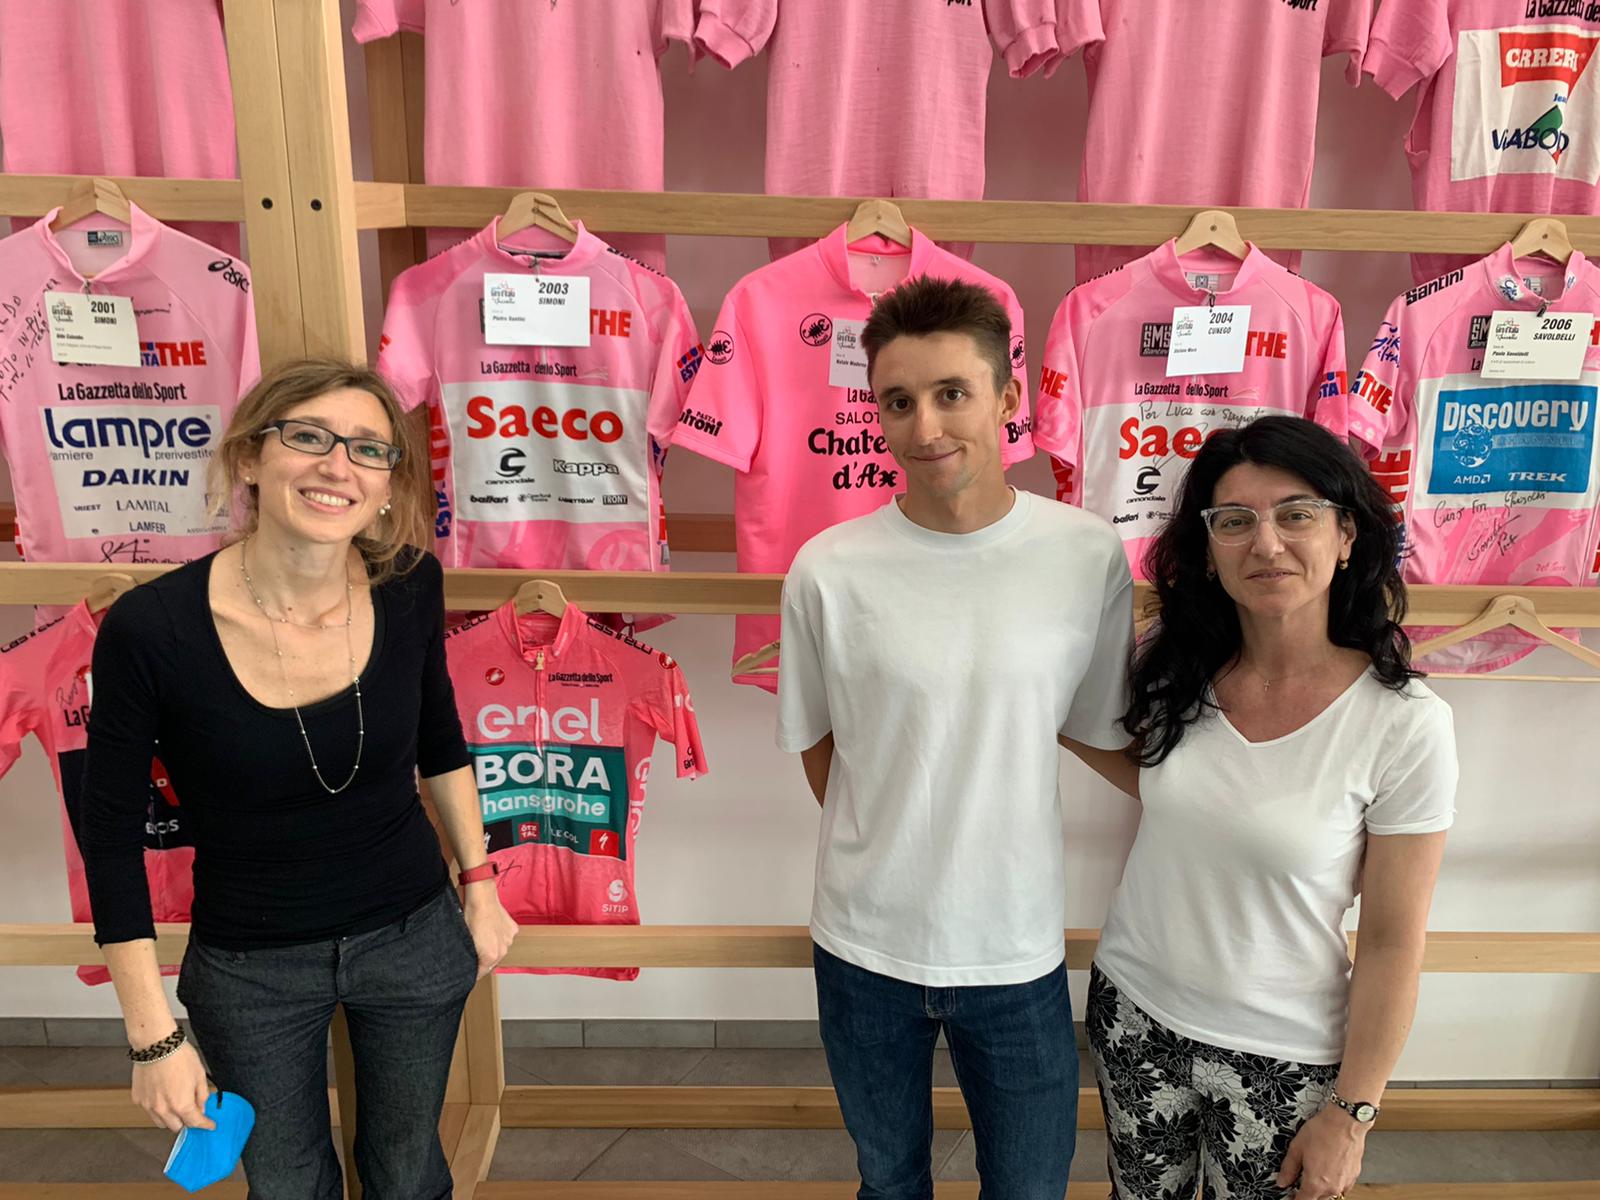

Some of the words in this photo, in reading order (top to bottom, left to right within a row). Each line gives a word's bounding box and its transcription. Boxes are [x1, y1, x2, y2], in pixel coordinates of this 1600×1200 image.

[538, 282, 569, 295] 2003
[90, 300, 115, 314] 2001
[538, 297, 566, 306] SIMONI
[93, 316, 117, 325] SIMONI
[1209, 312, 1234, 324] 2004
[1541, 318, 1573, 330] 2006
[1208, 326, 1232, 335] CUNEGO
[1533, 332, 1576, 341] SAVOLDELLI
[480, 361, 493, 375] La
[493, 360, 531, 375] Gazzetta
[534, 362, 554, 376] dello
[554, 362, 578, 377] Sport
[58, 383, 75, 401] La
[77, 383, 131, 400] Gazzetta
[131, 382, 153, 400] dello
[154, 383, 187, 403] Sport
[1134, 383, 1144, 395] La
[1144, 382, 1181, 396] Gazzetta
[1186, 382, 1204, 397] dello
[1204, 384, 1229, 398] Sport
[466, 395, 624, 443] Saeco
[696, 411, 716, 424] PASTA
[808, 427, 893, 456] Chate
[1119, 416, 1230, 461] Sae
[552, 458, 620, 476] Kappa
[82, 468, 190, 487] DAIKIN
[485, 477, 535, 485] cannondale
[1453, 475, 1480, 484] AMD
[1508, 471, 1567, 482] TREK
[116, 499, 173, 514] LAMITAL
[603, 496, 628, 505] TRONY
[129, 521, 167, 534] LAMFER
[548, 674, 556, 683] La
[556, 672, 581, 682] Gazzetta
[596, 673, 613, 684] Sport
[64, 708, 81, 727] La
[476, 697, 603, 744] enel
[475, 752, 611, 792] BORA
[483, 792, 606, 817] hansgrohe
[551, 829, 562, 838] LE
